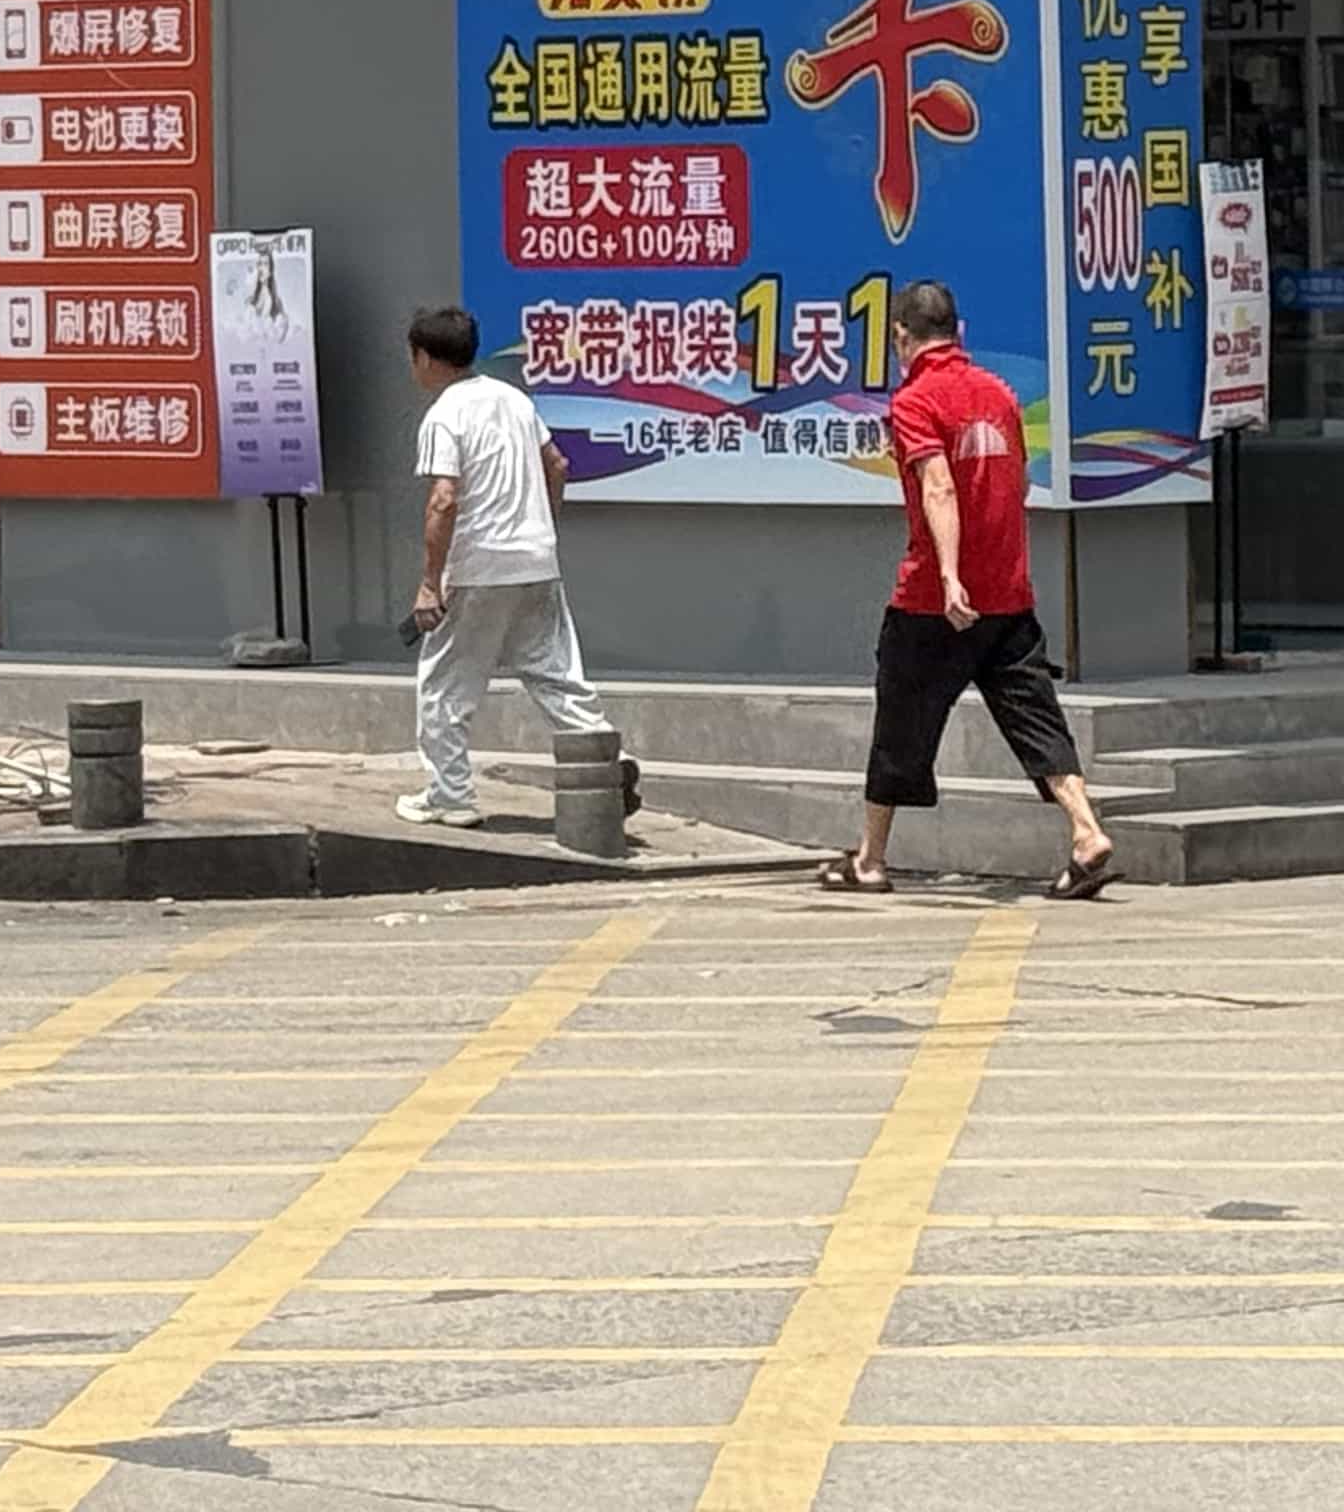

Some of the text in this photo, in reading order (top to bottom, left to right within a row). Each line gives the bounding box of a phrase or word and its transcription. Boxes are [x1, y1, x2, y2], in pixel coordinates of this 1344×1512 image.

[48, 6, 184, 57] 爆屏修复
[487, 35, 769, 128] 全国通用流量
[50, 104, 185, 153] 电池更换
[526, 155, 727, 219] 超大流量
[53, 201, 187, 251] 曲屏修复
[520, 219, 736, 262] 260G+100分钟
[54, 298, 189, 348] 刷机解锁
[521, 273, 896, 391] 宽带报装1天1
[56, 395, 191, 445] 主板维修
[762, 416, 883, 457] 值得信赖
